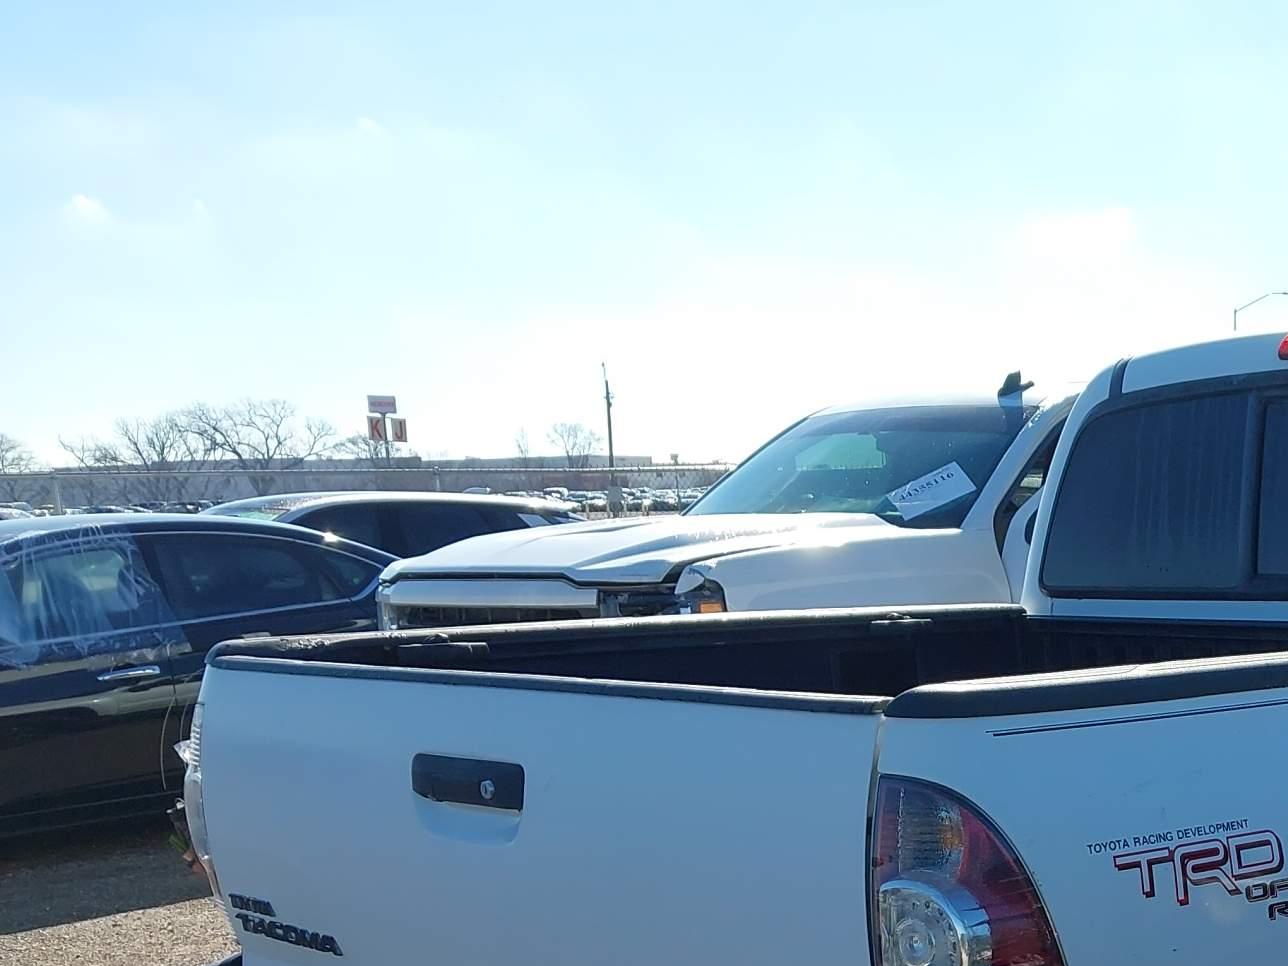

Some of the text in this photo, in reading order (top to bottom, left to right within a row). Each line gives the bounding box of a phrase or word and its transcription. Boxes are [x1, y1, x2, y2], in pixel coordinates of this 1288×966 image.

[371, 418, 383, 440] K
[1087, 818, 1250, 855] TOYOTA RACING DEVELOPMENT
[1112, 828, 1286, 906] TRD
[235, 912, 344, 957] TACOMA
